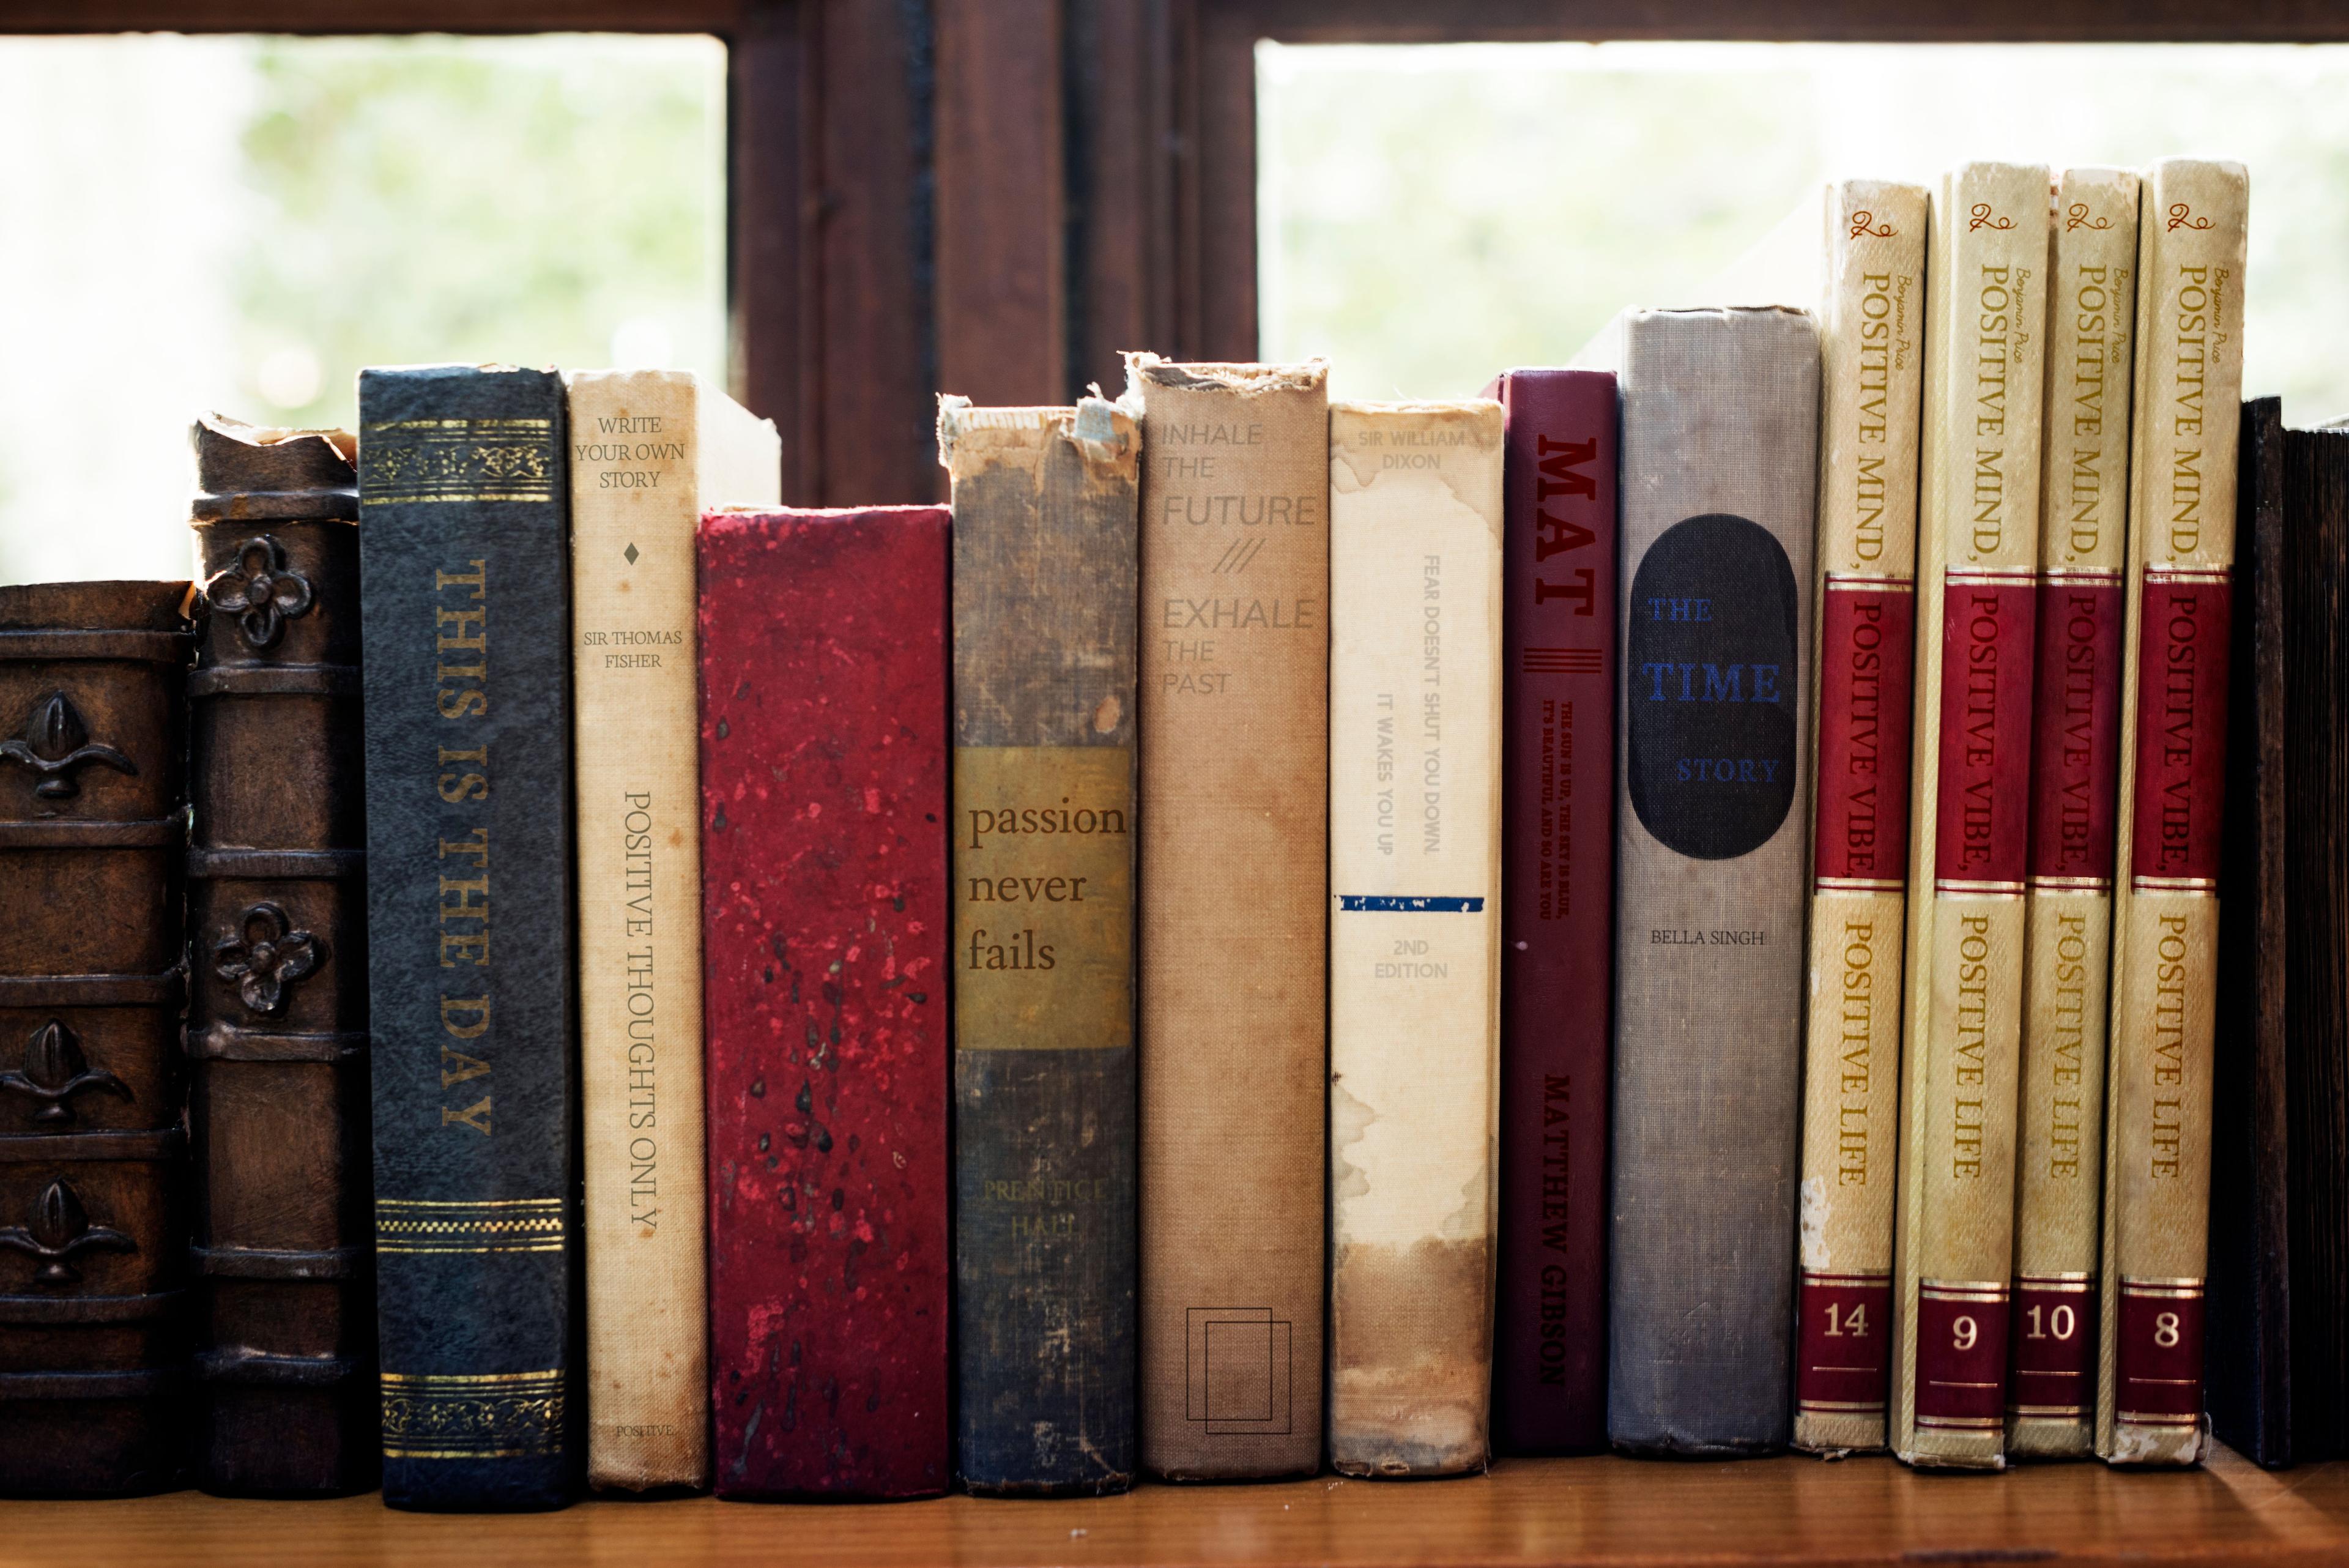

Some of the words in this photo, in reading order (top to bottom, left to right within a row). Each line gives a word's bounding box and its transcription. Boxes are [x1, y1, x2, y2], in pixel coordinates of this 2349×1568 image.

[1893, 275, 1912, 338] Benjamin
[2013, 267, 2031, 329] Benjamin
[2110, 267, 2128, 329] Benjamin
[2211, 267, 2228, 329] Benjamin
[1858, 272, 1890, 444] POSITIVE
[1896, 338, 1910, 371] Price
[1977, 264, 2009, 436] POSITIVE
[2014, 331, 2028, 363] Price
[2074, 264, 2107, 436] POSITIVE
[2112, 331, 2126, 363] Price
[2175, 264, 2207, 436] POSITIVE
[2213, 331, 2227, 363] Price
[598, 417, 662, 434] WRITE
[1162, 424, 1262, 445] INHALE
[1358, 431, 1382, 446] SIR
[1390, 431, 1464, 446] WILLIAM
[575, 445, 633, 461] YOUR
[637, 444, 685, 460] OWN
[1163, 457, 1216, 478] THE
[1382, 454, 1440, 470] DIXON
[599, 471, 661, 488] STORY
[1163, 496, 1316, 526] FUTURE
[1535, 434, 1597, 616] MAT
[1850, 455, 1885, 570] MIND,
[1968, 448, 2003, 562] MIND,
[2065, 448, 2101, 562] MIND,
[2166, 448, 2202, 562] MIND,
[1424, 555, 1439, 600] FEAR
[1162, 599, 1315, 628] EXHALE
[1648, 598, 1712, 622] THE
[436, 559, 488, 719] THIS
[584, 631, 608, 645] SIR
[612, 631, 682, 645] THOMAS
[1162, 641, 1215, 661] THE
[1424, 607, 1439, 686] DOESN'T
[604, 655, 662, 669] FISHER
[1966, 594, 1999, 768] POSITIVE
[2063, 594, 2096, 768] POSITIVE
[2164, 594, 2197, 768] POSITIVE
[1162, 674, 1231, 694] PAST
[1378, 694, 1393, 710] IT
[1642, 664, 1780, 702] TIME
[1849, 601, 1881, 775] POSITIVE
[1424, 693, 1439, 741] SHUT
[1561, 701, 1572, 729] THE
[1378, 717, 1393, 781] WAKES
[1542, 727, 1554, 804] BEAUTIFUL
[1560, 734, 1572, 759] SUN
[437, 745, 488, 803] IS
[1424, 748, 1439, 787] YOU
[1560, 763, 1572, 775] IS
[1676, 759, 1779, 782] STORY
[1378, 788, 1393, 827] YOU
[1559, 779, 1571, 801] UP,
[968, 797, 1127, 849] passion
[1541, 808, 1553, 837] AND
[1559, 804, 1570, 832] THE
[1842, 783, 1877, 878] VIBE,
[1958, 776, 1993, 871] VIBE,
[2055, 776, 2090, 871] VIBE,
[2156, 776, 2191, 871] VIBE,
[1378, 833, 1393, 855] UP
[1541, 841, 1552, 857] SO
[1559, 836, 1570, 861] SKY
[625, 792, 653, 937] POSITIVE
[1540, 861, 1552, 888] ARE
[1559, 864, 1570, 877] IS
[439, 828, 490, 967] THE
[968, 877, 1086, 902] never
[1540, 893, 1551, 920] YOU
[1556, 880, 1570, 920] BLUE,
[968, 929, 1055, 970] fails
[1393, 940, 1430, 956] 2ND
[1651, 930, 1705, 945] BELLA
[1710, 931, 1765, 946] SINGH
[1375, 963, 1448, 979] EDITION
[1841, 921, 1872, 1093] POSITIVE
[1956, 913, 1989, 1086] POSITIVE
[2053, 913, 2085, 1086] POSITIVE
[2154, 913, 2186, 1086] POSITIVE
[627, 946, 656, 1129] THOUGHTS
[440, 994, 491, 1136] DAY
[1839, 1104, 1868, 1187] LIFE
[1953, 1097, 1983, 1179] LIFE
[2050, 1097, 2080, 1179] LIFE
[2151, 1097, 2181, 1179] LIFE
[629, 1137, 657, 1229] ONLY
[1542, 1074, 1570, 1254] MATTHEW
[1540, 1265, 1567, 1386] GIBSON
[1824, 1302, 1868, 1337] 14
[1953, 1315, 1978, 1350] 9
[2027, 1304, 2075, 1340] 10
[2154, 1312, 2179, 1347] 8
[616, 1424, 674, 1437] POSITIVE
